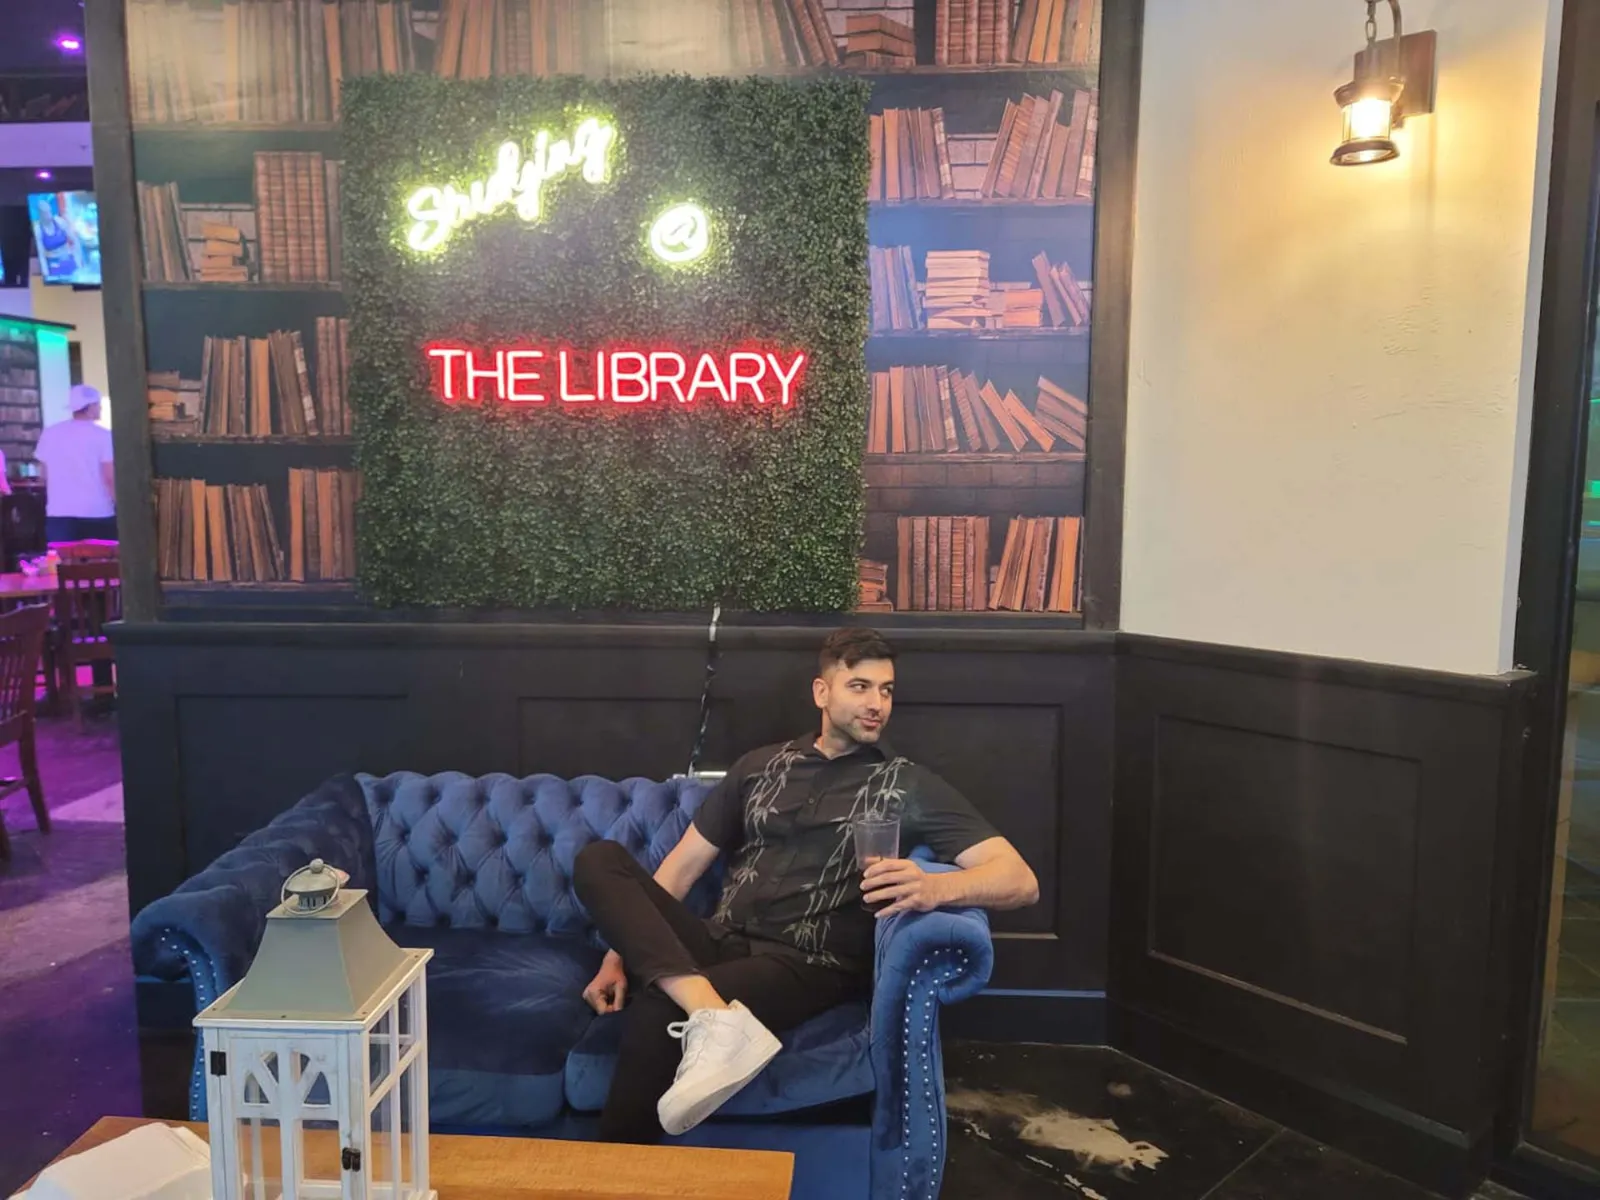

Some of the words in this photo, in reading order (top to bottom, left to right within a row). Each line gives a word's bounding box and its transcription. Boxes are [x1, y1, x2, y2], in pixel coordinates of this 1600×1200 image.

[406, 116, 615, 254] Studying
[648, 201, 710, 264] @
[428, 347, 547, 403] THE
[558, 350, 806, 406] LIBRARY
